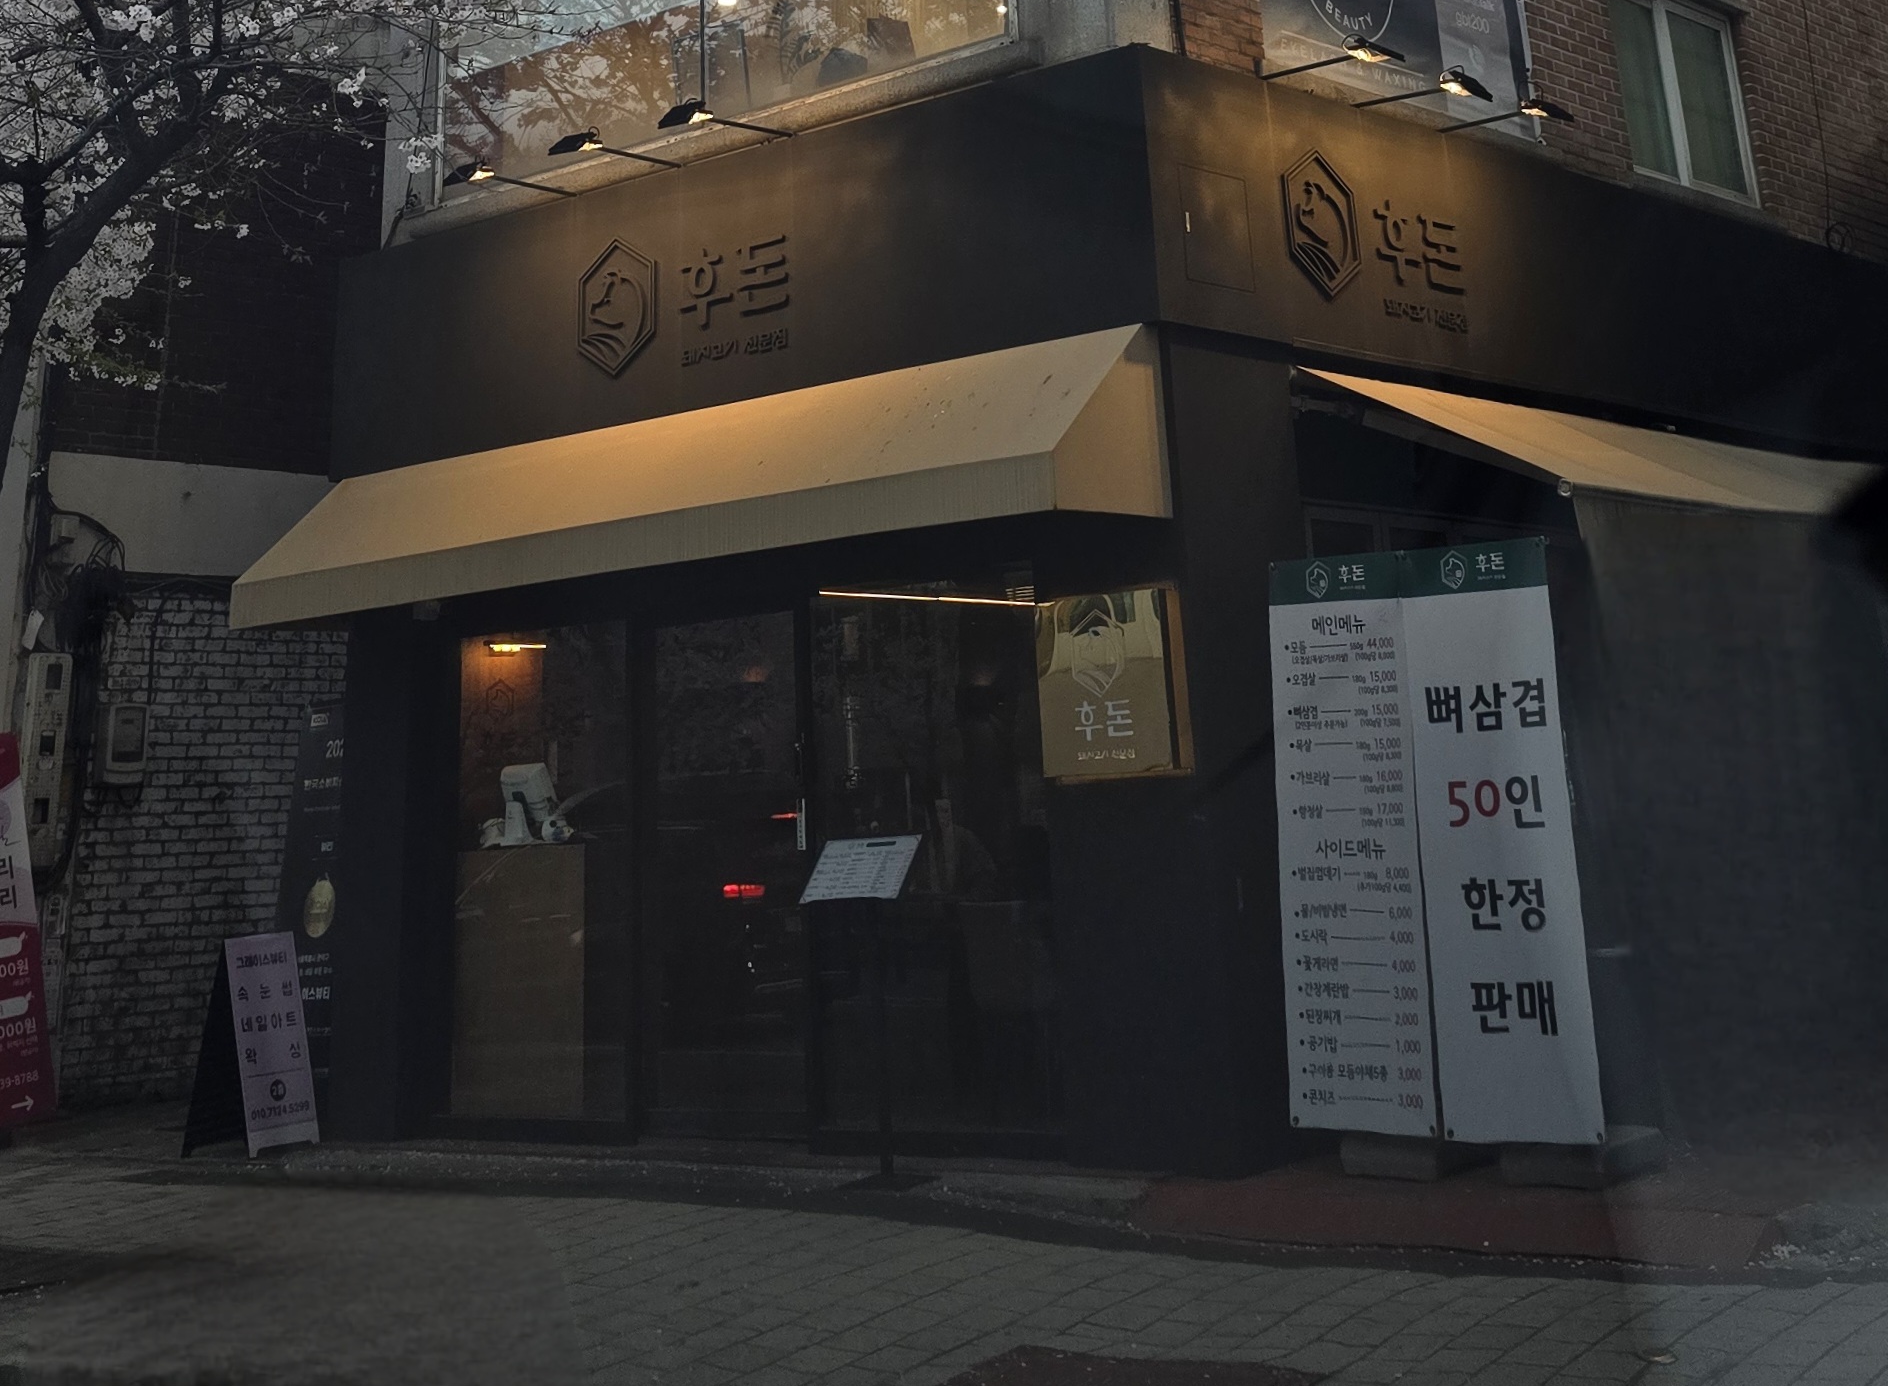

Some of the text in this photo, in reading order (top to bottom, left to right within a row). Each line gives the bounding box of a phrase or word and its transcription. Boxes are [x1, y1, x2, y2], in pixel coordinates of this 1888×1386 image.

[1324, 0, 1374, 31] BEAUTY
[1372, 199, 1467, 297] 후돈
[680, 233, 791, 332] 후돈
[1475, 552, 1505, 573] 후돈
[1338, 564, 1365, 583] 후돈
[1311, 614, 1367, 636] 메인메뉴
[1291, 672, 1316, 687] 오겹살
[1369, 670, 1397, 684] 15,000
[1371, 703, 1399, 717] 15,000
[1424, 677, 1550, 734] 뼈삼겹
[1074, 699, 1134, 742] 후돈
[1374, 737, 1402, 751] 15,000
[1376, 769, 1404, 783] 16,000
[1377, 802, 1404, 816] 17,000
[1447, 773, 1547, 831] 50인
[1315, 837, 1386, 860] 사이드메뉴
[1460, 876, 1549, 934] 한정
[1301, 928, 1328, 946] 도시락
[1393, 985, 1418, 1002] 3,000
[1469, 979, 1560, 1037] 판매
[1307, 1035, 1422, 1055] 공기밥 1,000
